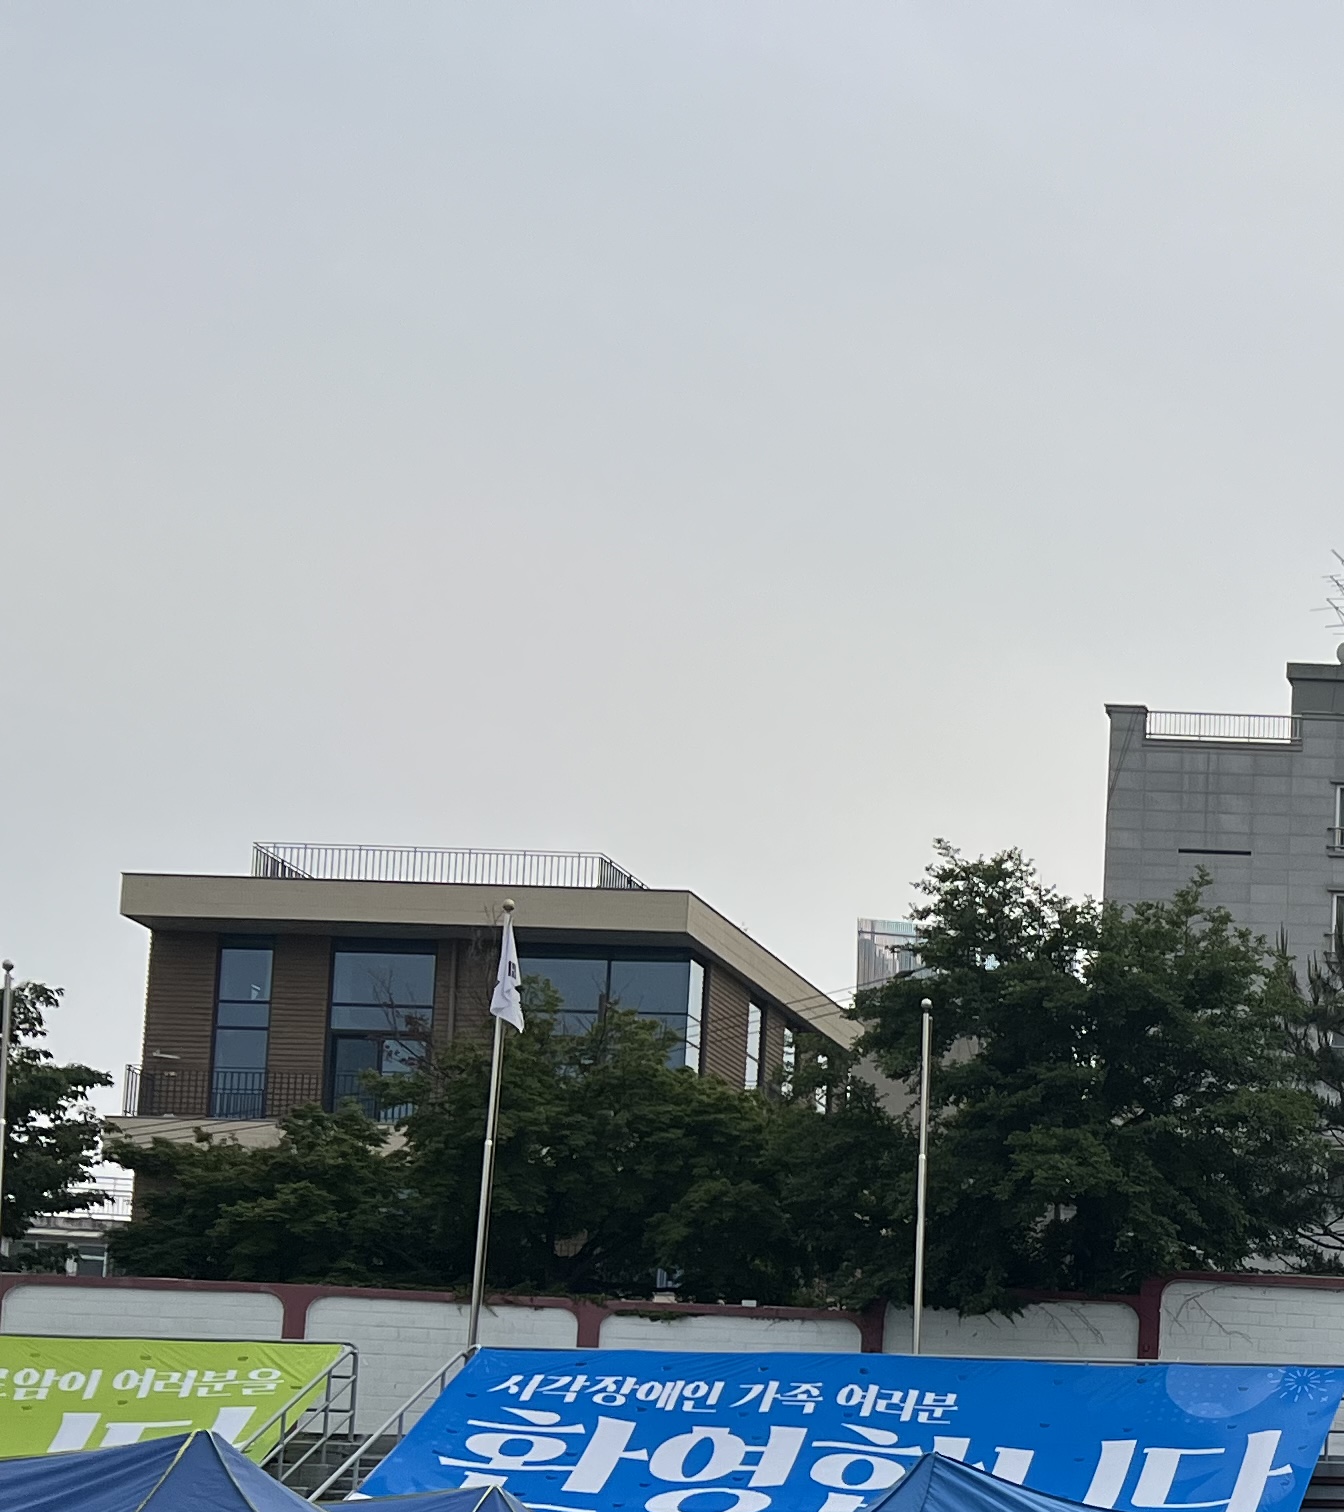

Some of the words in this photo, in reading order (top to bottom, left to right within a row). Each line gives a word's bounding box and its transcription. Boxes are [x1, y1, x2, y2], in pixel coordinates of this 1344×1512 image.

[0, 1367, 102, 1400] 암이
[112, 1367, 284, 1399] 여러분을
[487, 1373, 723, 1414] 시각장애인
[729, 1380, 823, 1415] 가족
[835, 1382, 959, 1425] 여러분
